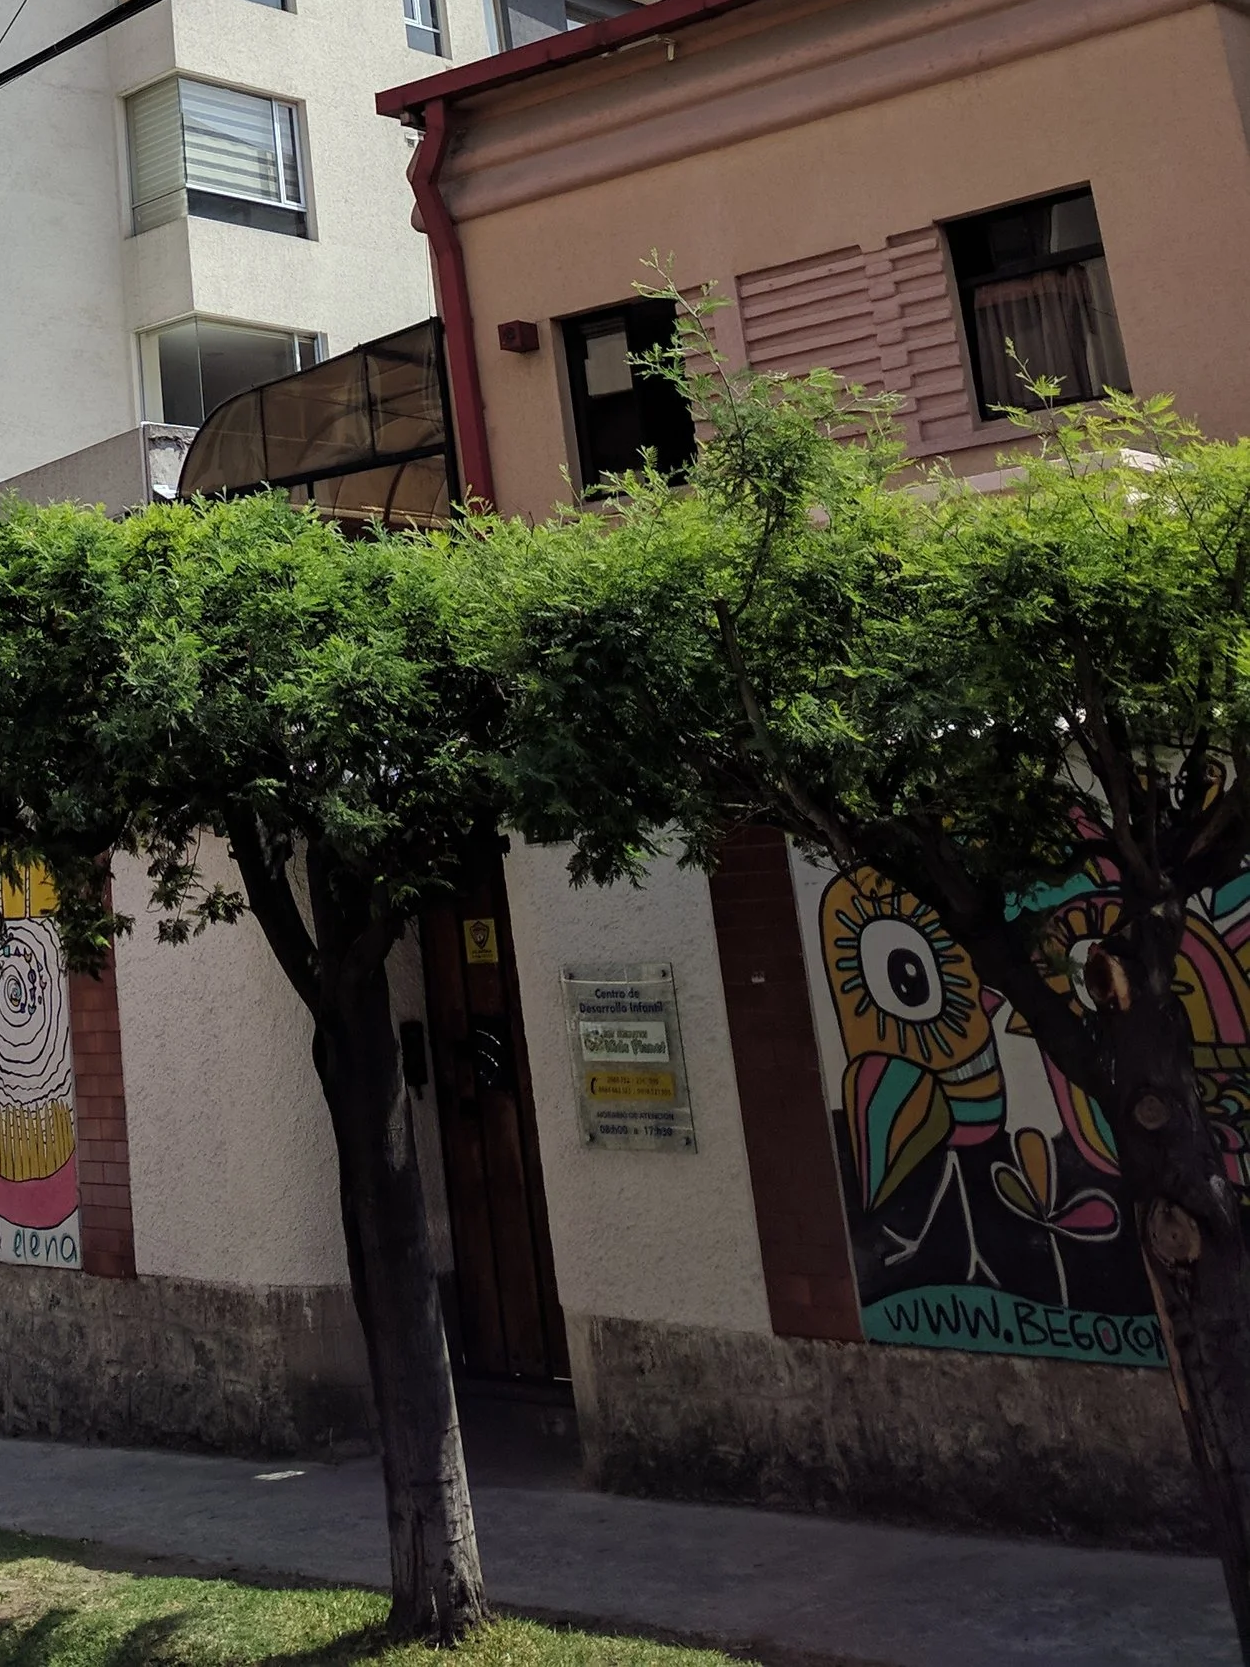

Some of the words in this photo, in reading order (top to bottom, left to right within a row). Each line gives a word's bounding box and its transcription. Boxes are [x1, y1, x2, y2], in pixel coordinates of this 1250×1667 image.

[595, 988, 626, 999] Centro
[628, 987, 640, 998] de
[579, 1002, 627, 1013] Desarrollo
[630, 1001, 663, 1013] Infantil
